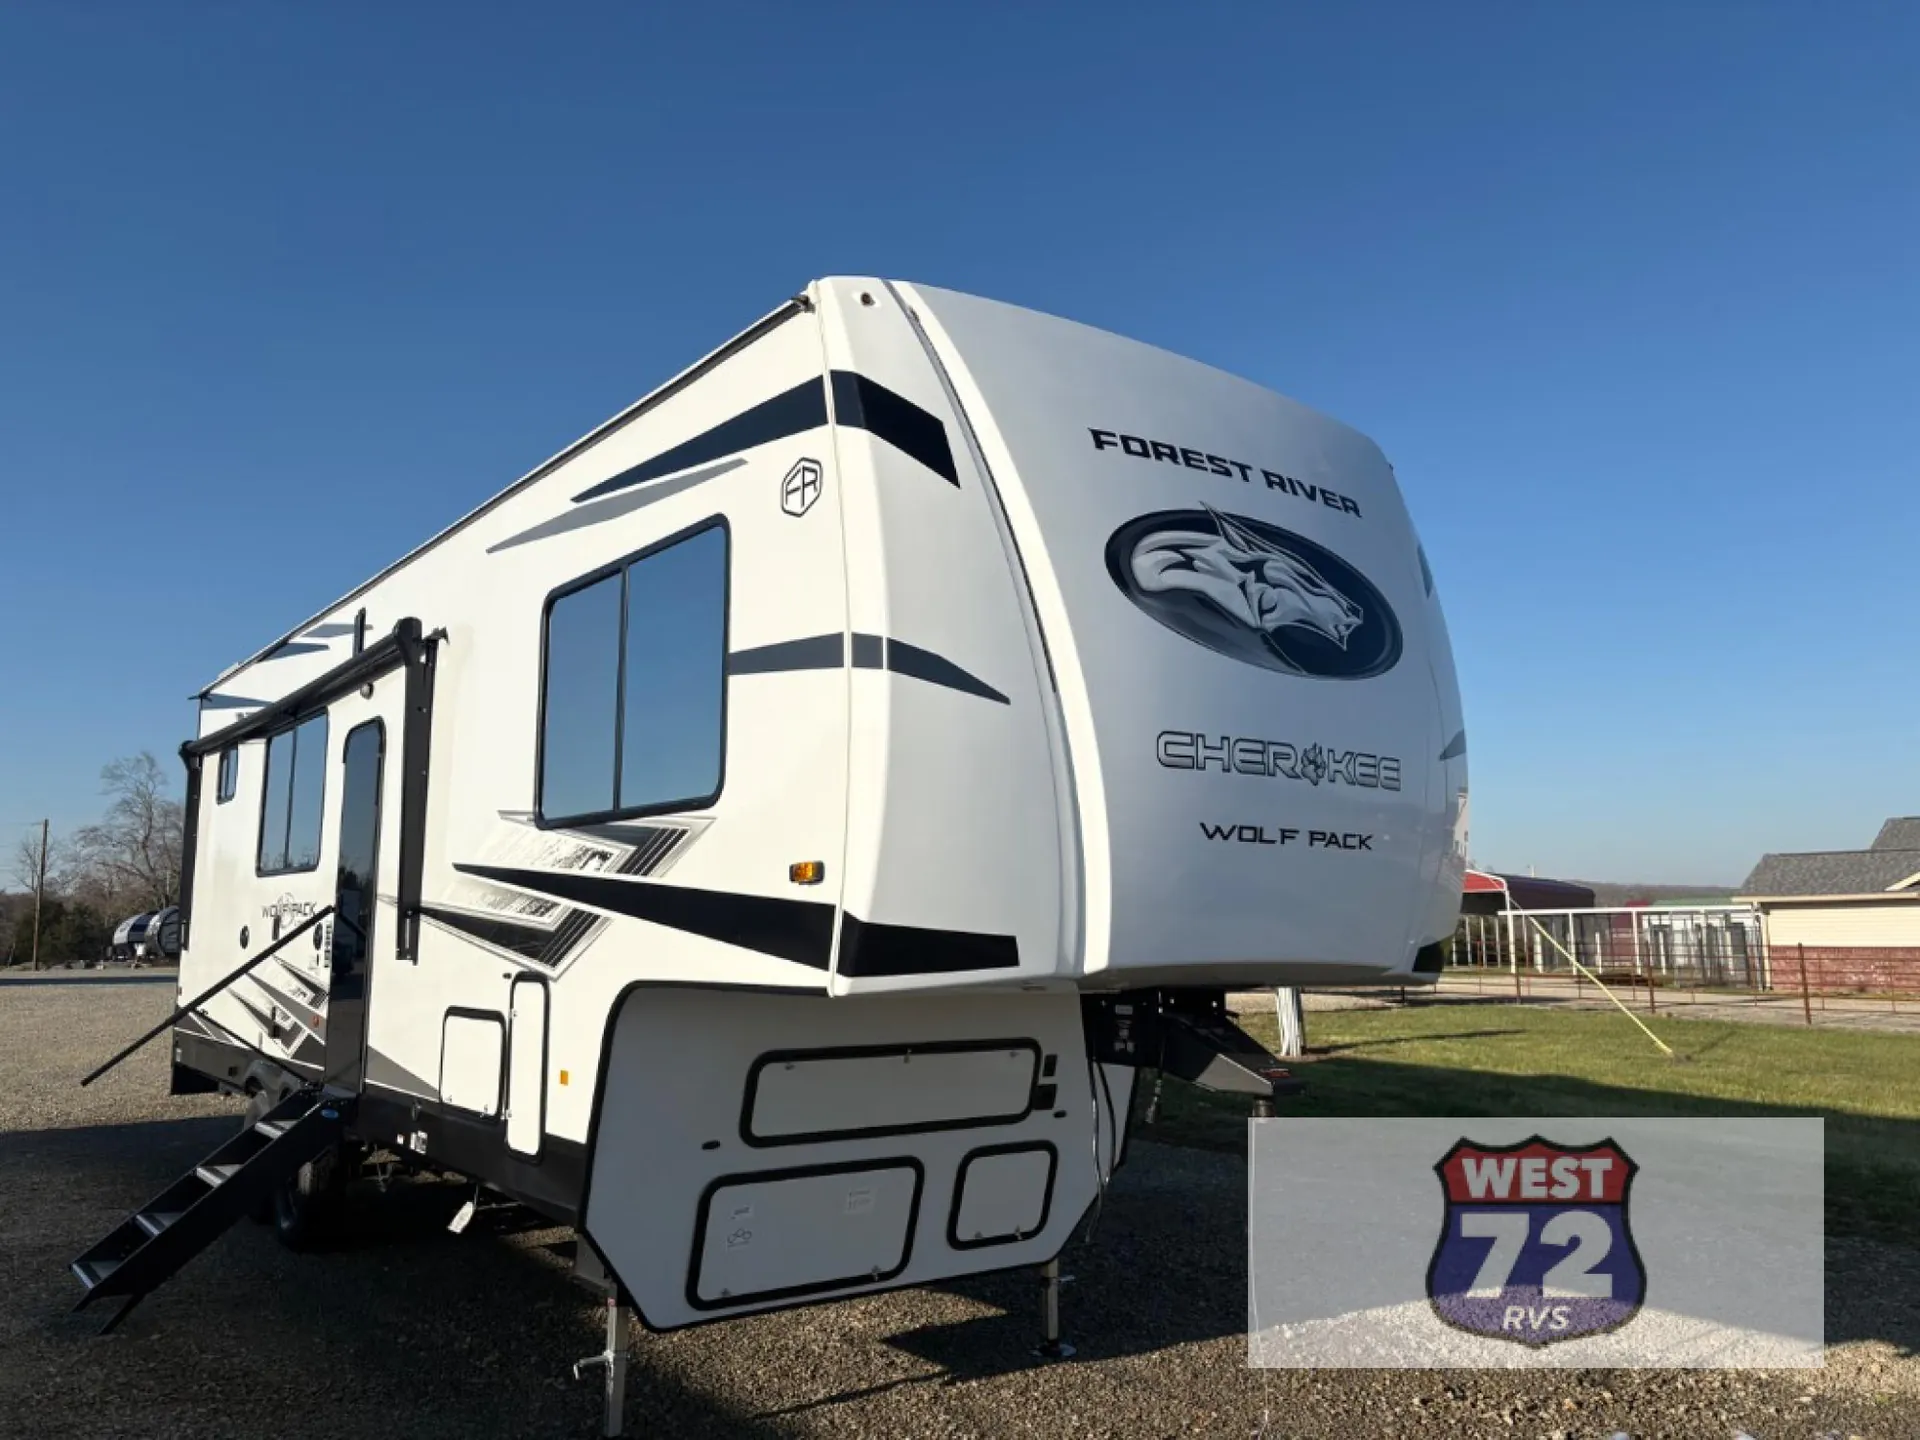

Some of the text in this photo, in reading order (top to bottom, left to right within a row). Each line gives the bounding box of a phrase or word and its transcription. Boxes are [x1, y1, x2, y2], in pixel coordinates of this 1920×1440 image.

[1088, 427, 1362, 518] FOREST RIVER
[1199, 822, 1374, 850] WOLF PACK
